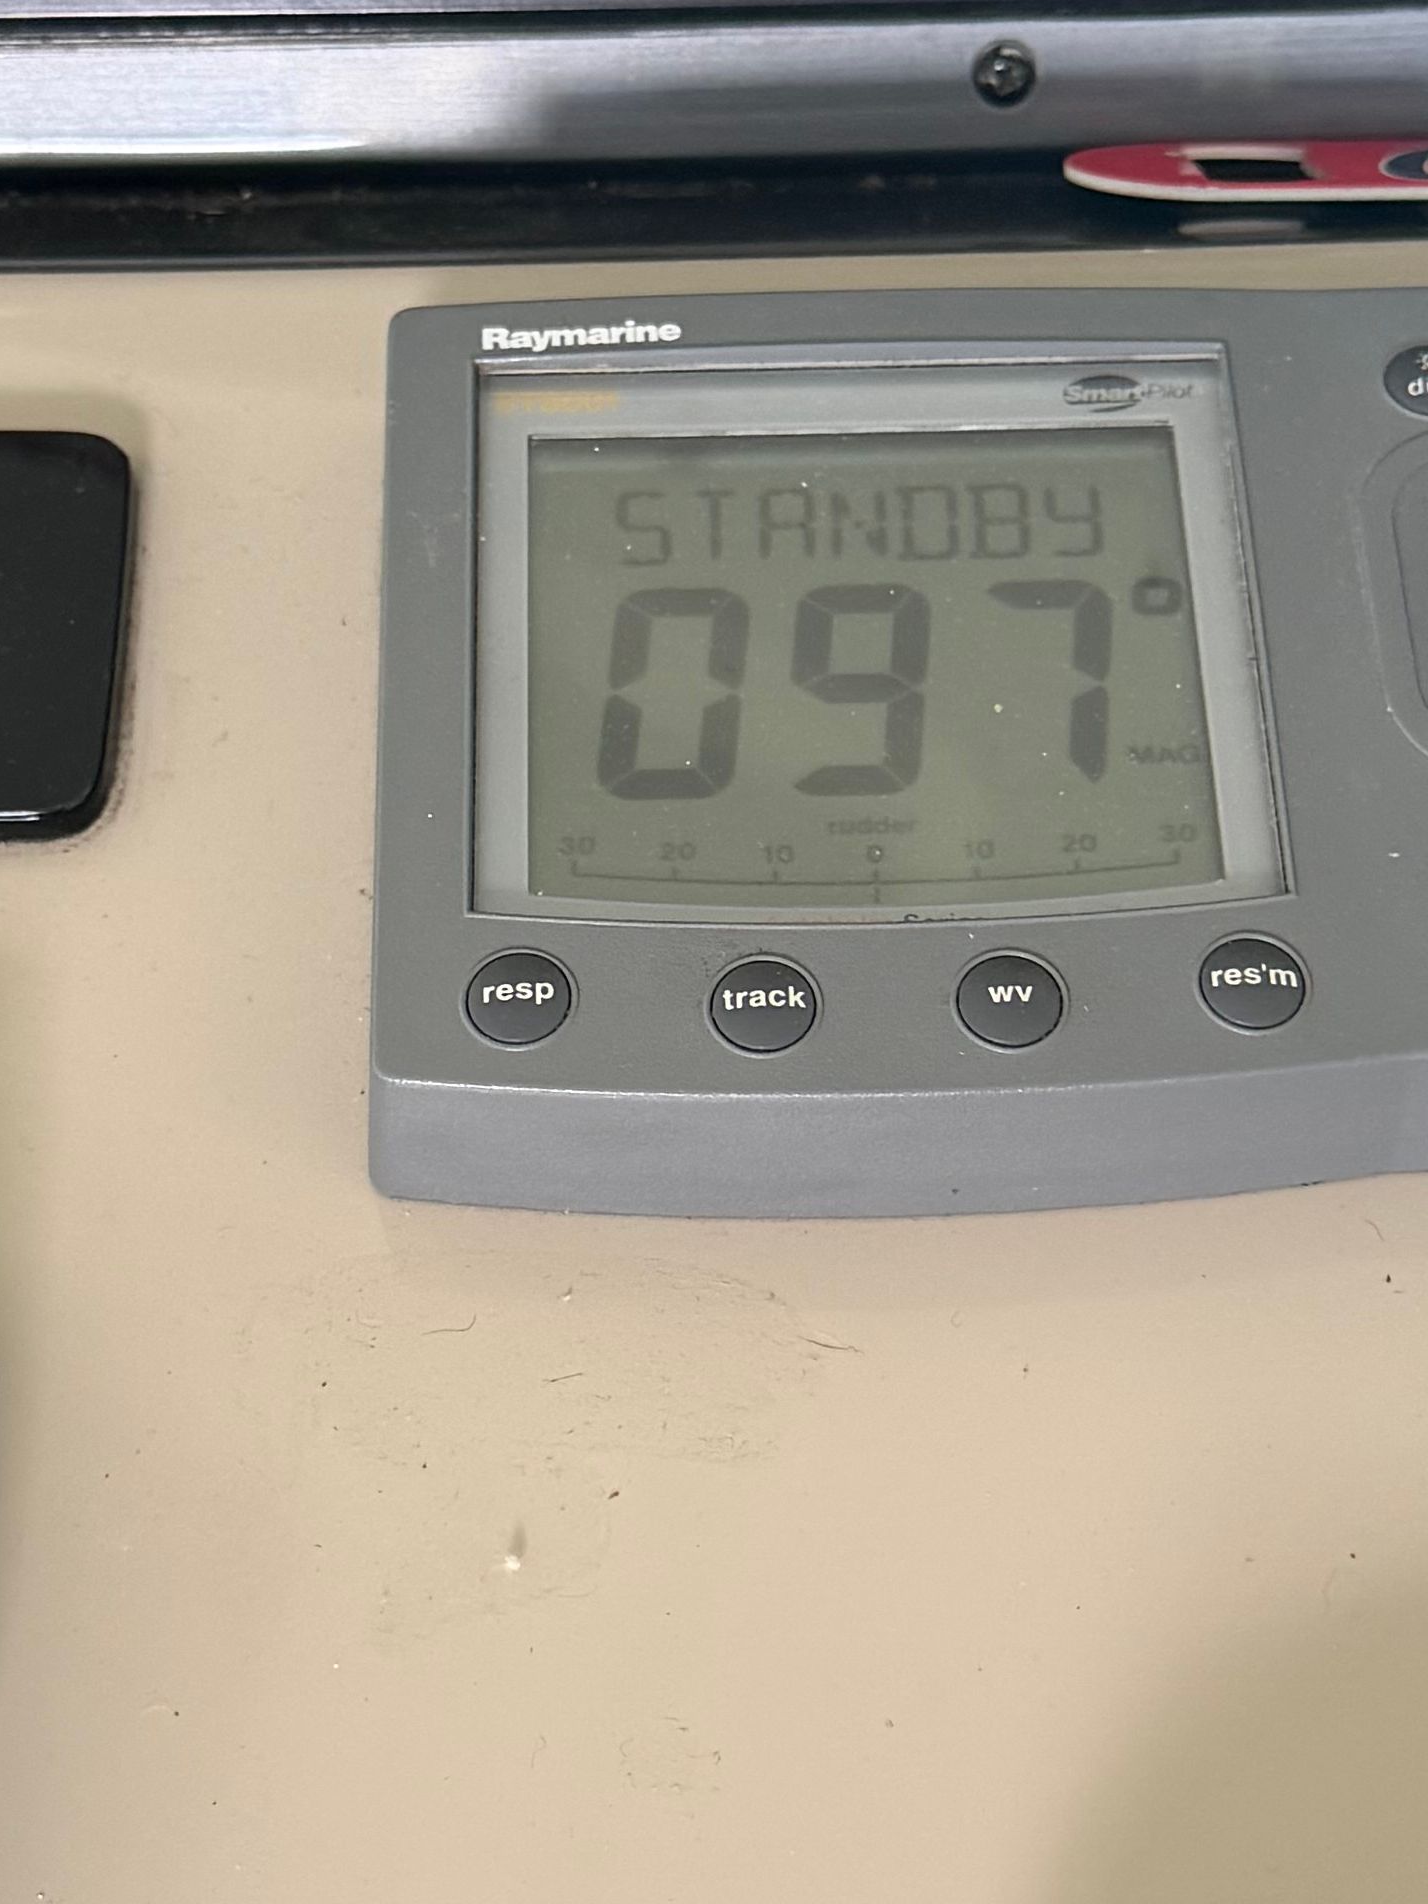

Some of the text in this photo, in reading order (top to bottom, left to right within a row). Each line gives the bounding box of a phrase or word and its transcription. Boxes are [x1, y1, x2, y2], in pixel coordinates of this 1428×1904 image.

[481, 319, 682, 352] Raymarine
[614, 484, 1105, 567] STANDBY
[1210, 962, 1298, 990] res'm
[480, 980, 555, 1006] resp
[722, 983, 807, 1012] track
[988, 983, 1034, 1005] wv
